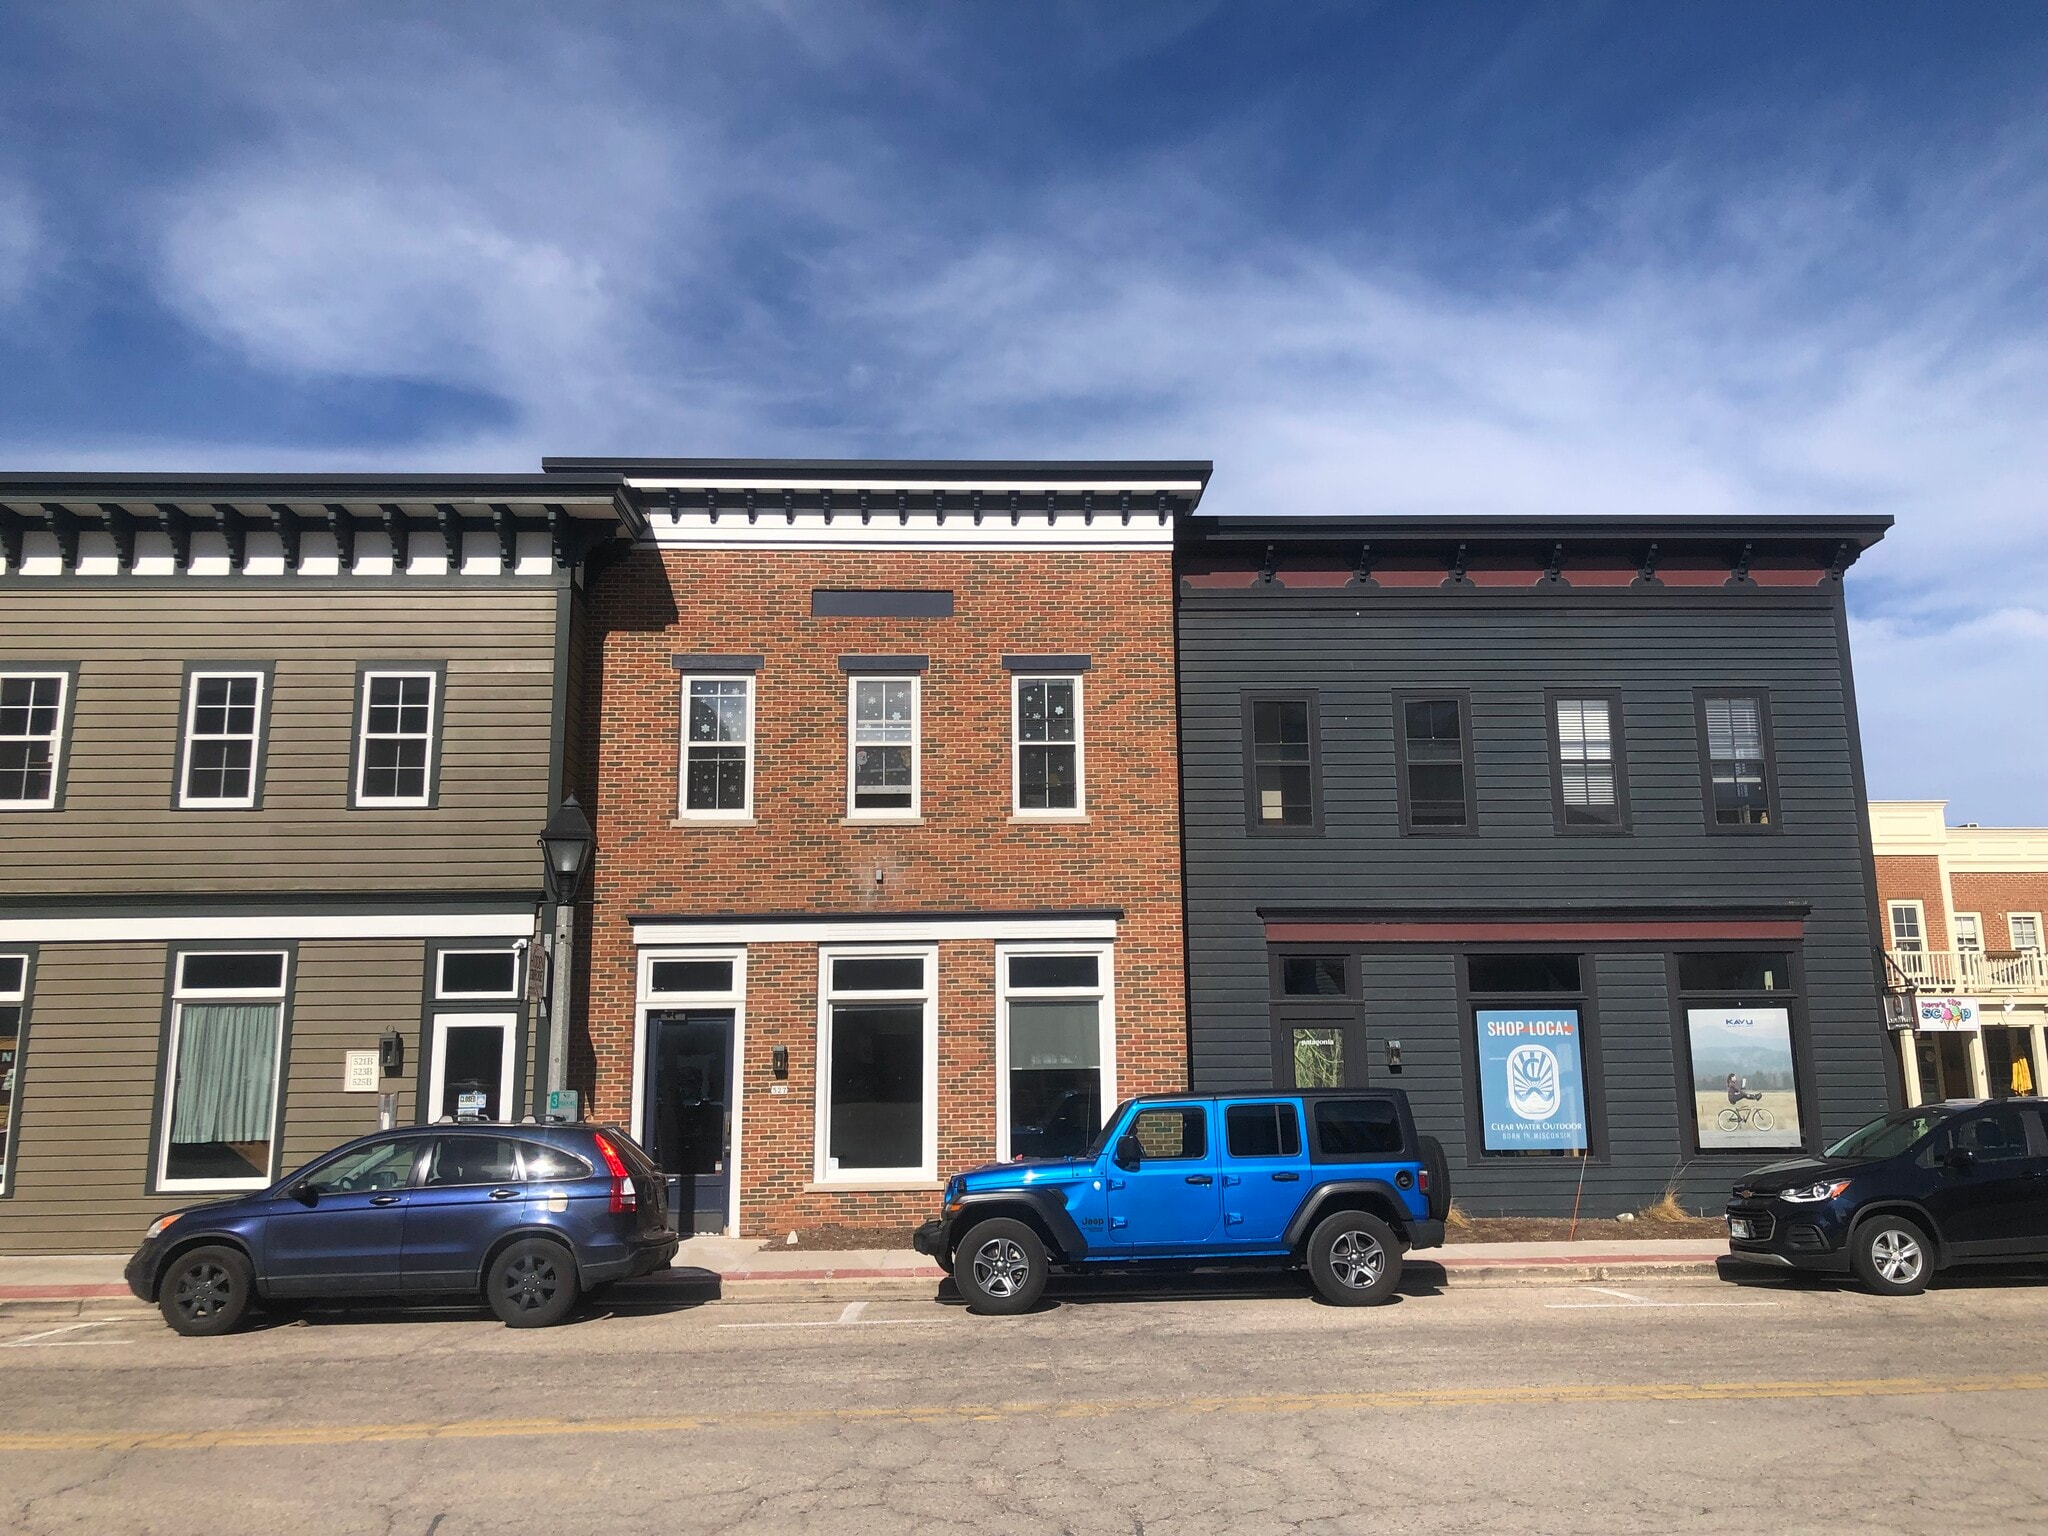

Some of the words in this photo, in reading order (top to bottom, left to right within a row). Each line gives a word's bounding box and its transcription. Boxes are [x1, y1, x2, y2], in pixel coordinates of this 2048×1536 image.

[1487, 1021, 1524, 1037] SHOP
[1528, 1020, 1572, 1036] LOCAL
[353, 1057, 374, 1066] 521B
[352, 1067, 373, 1076] 523B
[352, 1078, 373, 1086] 525B
[773, 1086, 787, 1094] 527
[1491, 1122, 1514, 1131] CLEAR
[1515, 1122, 1541, 1131] WATER
[1542, 1122, 1582, 1131] OUTDOOR
[1502, 1132, 1521, 1140] BORN
[1533, 1132, 1571, 1140] WISCONSIN
[1081, 1217, 1104, 1226] Jeep
